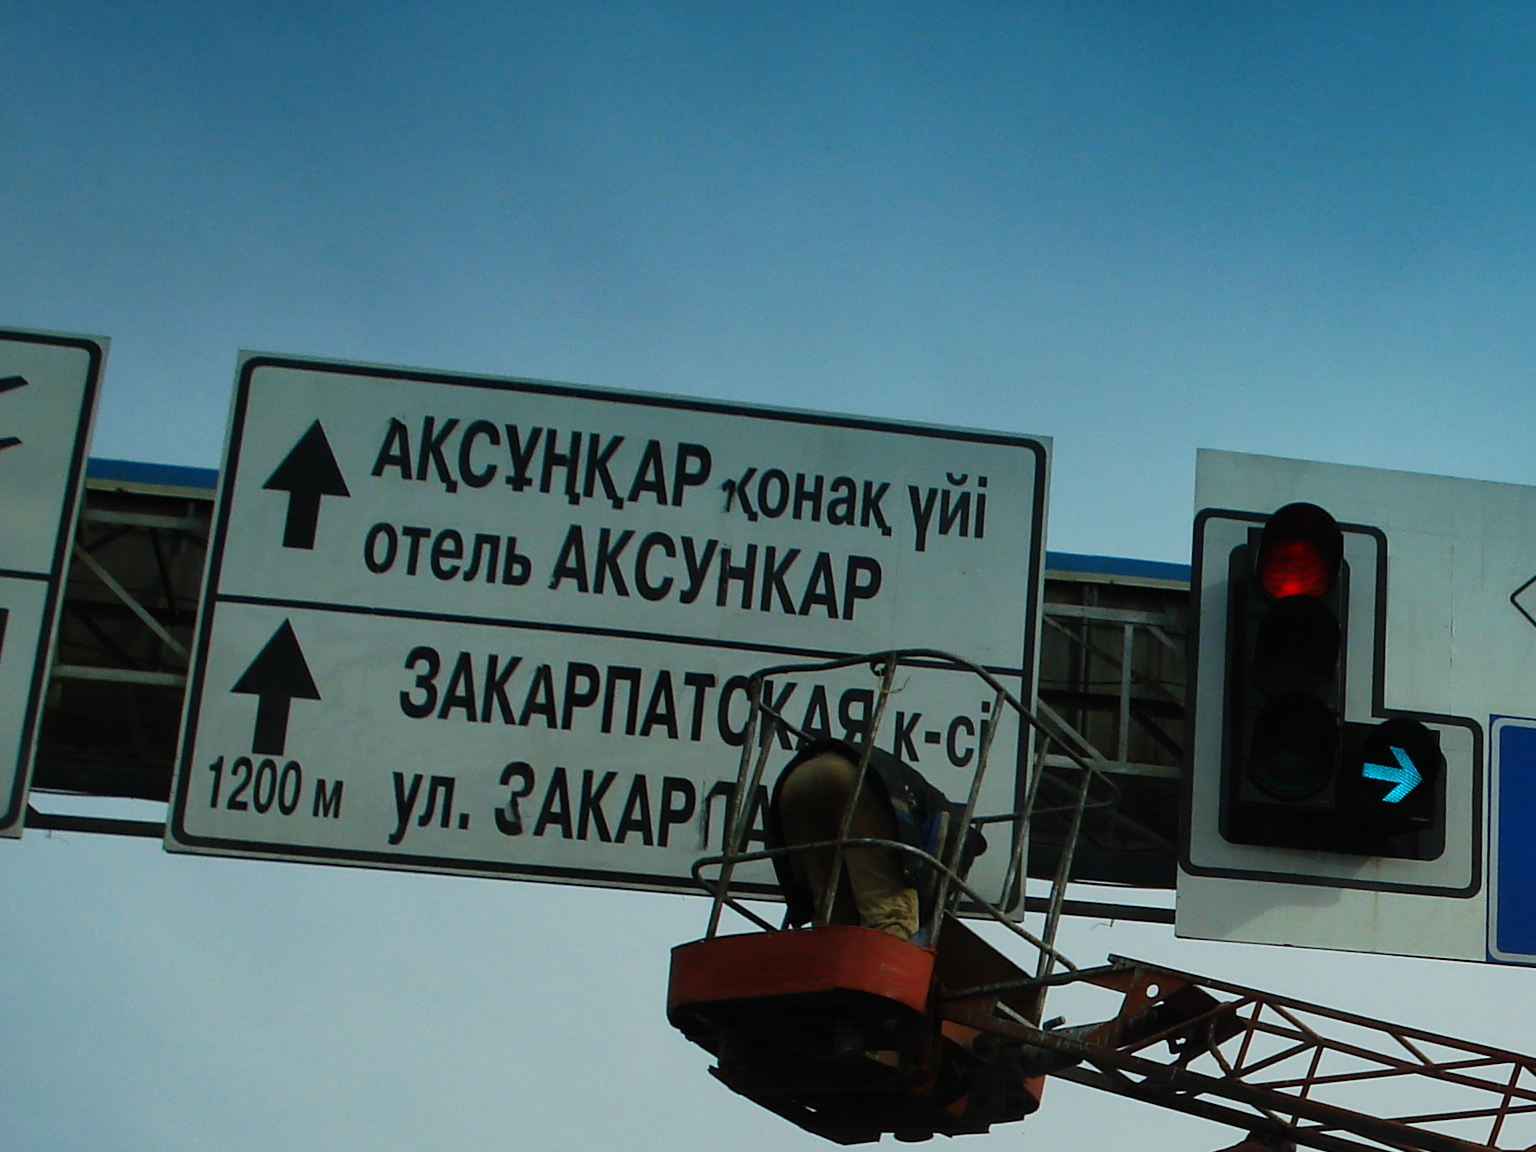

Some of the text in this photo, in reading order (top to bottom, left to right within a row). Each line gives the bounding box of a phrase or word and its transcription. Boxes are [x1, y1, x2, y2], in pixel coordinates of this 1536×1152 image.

[371, 416, 713, 510] АҚСҰҢҚАР
[908, 472, 988, 552] үйі
[364, 522, 882, 620] отель АКСУНКАР
[208, 756, 344, 819] 1200 м
[388, 761, 775, 853] ул. ЗАКАРПА
